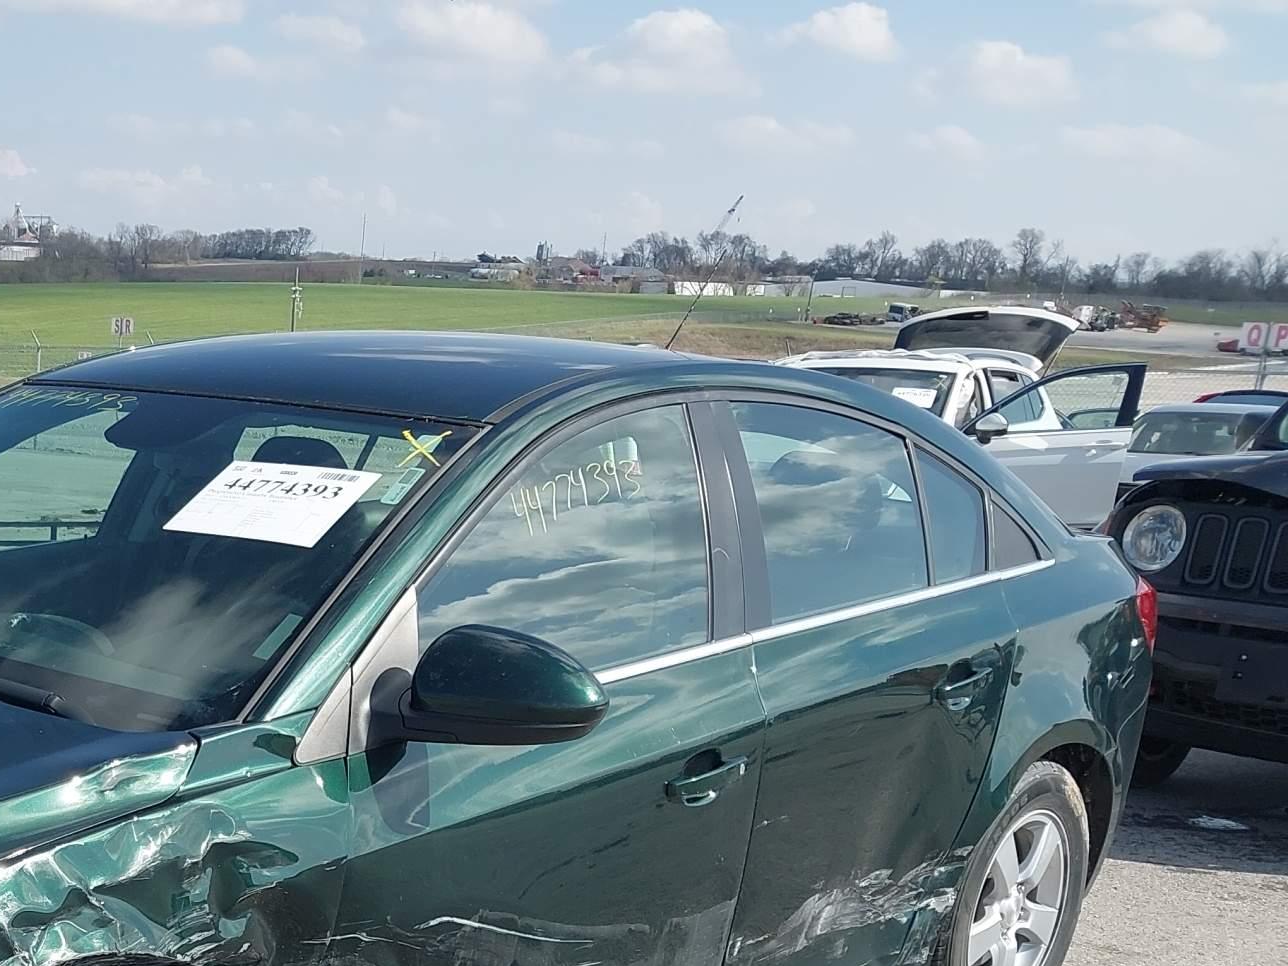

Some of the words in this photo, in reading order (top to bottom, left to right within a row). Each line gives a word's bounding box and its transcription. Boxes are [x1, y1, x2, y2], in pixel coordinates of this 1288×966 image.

[114, 319, 120, 334] S
[125, 319, 131, 334] R
[1247, 324, 1262, 347] Q
[224, 477, 344, 500] 44774393
[510, 459, 641, 537] 44774393
